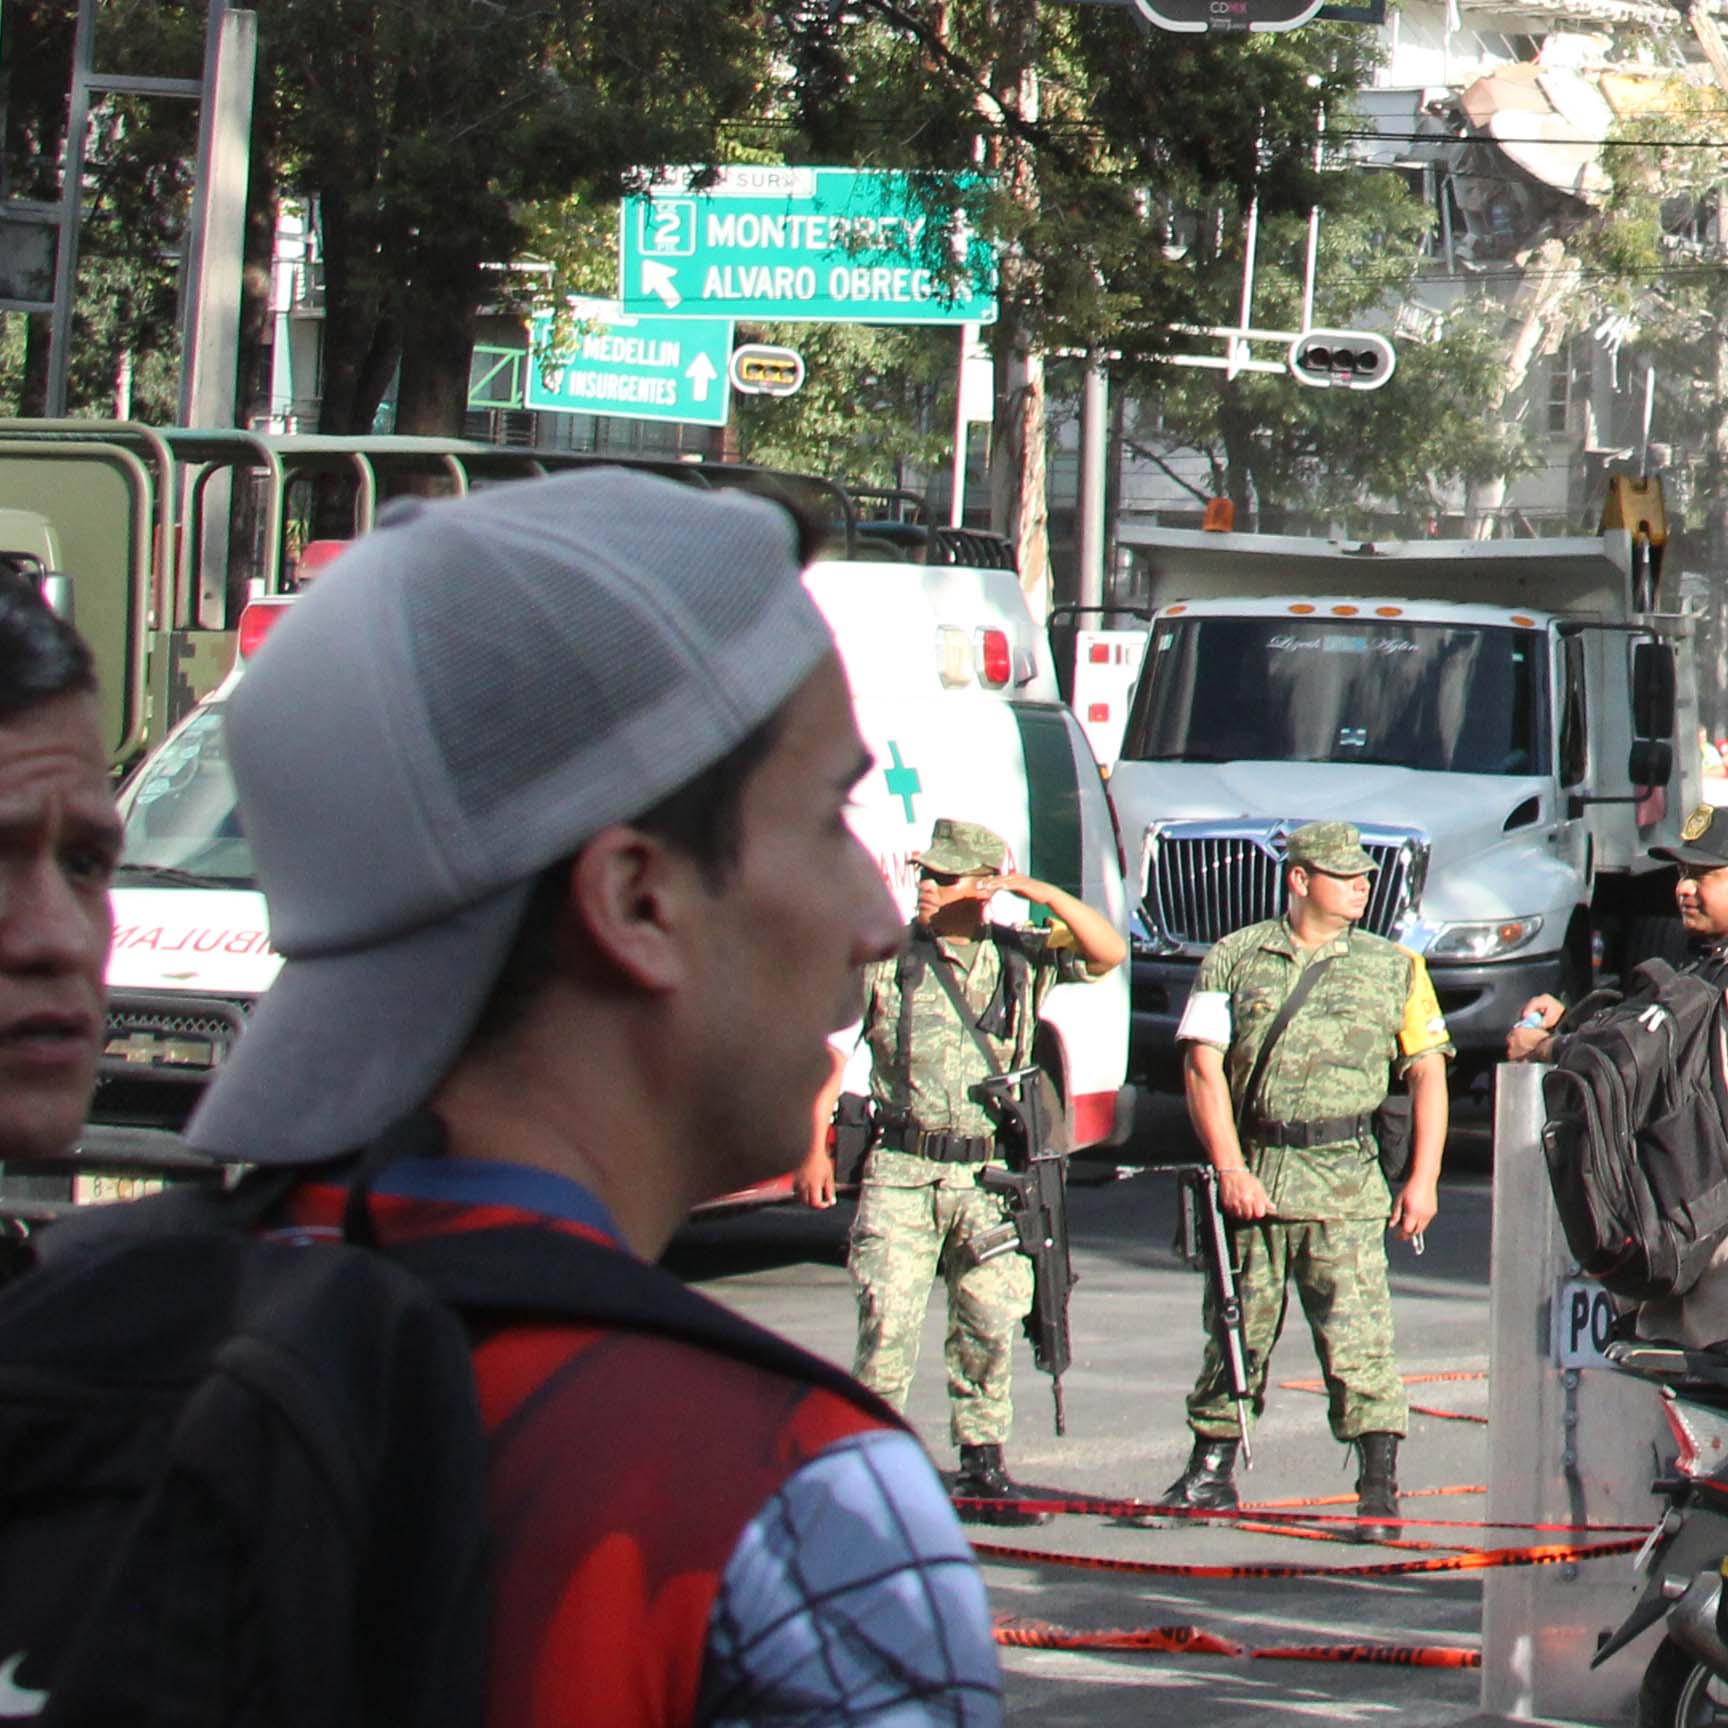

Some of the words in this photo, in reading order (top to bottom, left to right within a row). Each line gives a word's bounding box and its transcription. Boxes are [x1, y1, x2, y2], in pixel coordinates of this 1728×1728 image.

[654, 214, 682, 245] 2
[705, 212, 927, 252] MONTERREY
[701, 266, 817, 301] ALVARO
[582, 334, 681, 368] MEDELLIN
[568, 369, 677, 407] INSURGENTES
